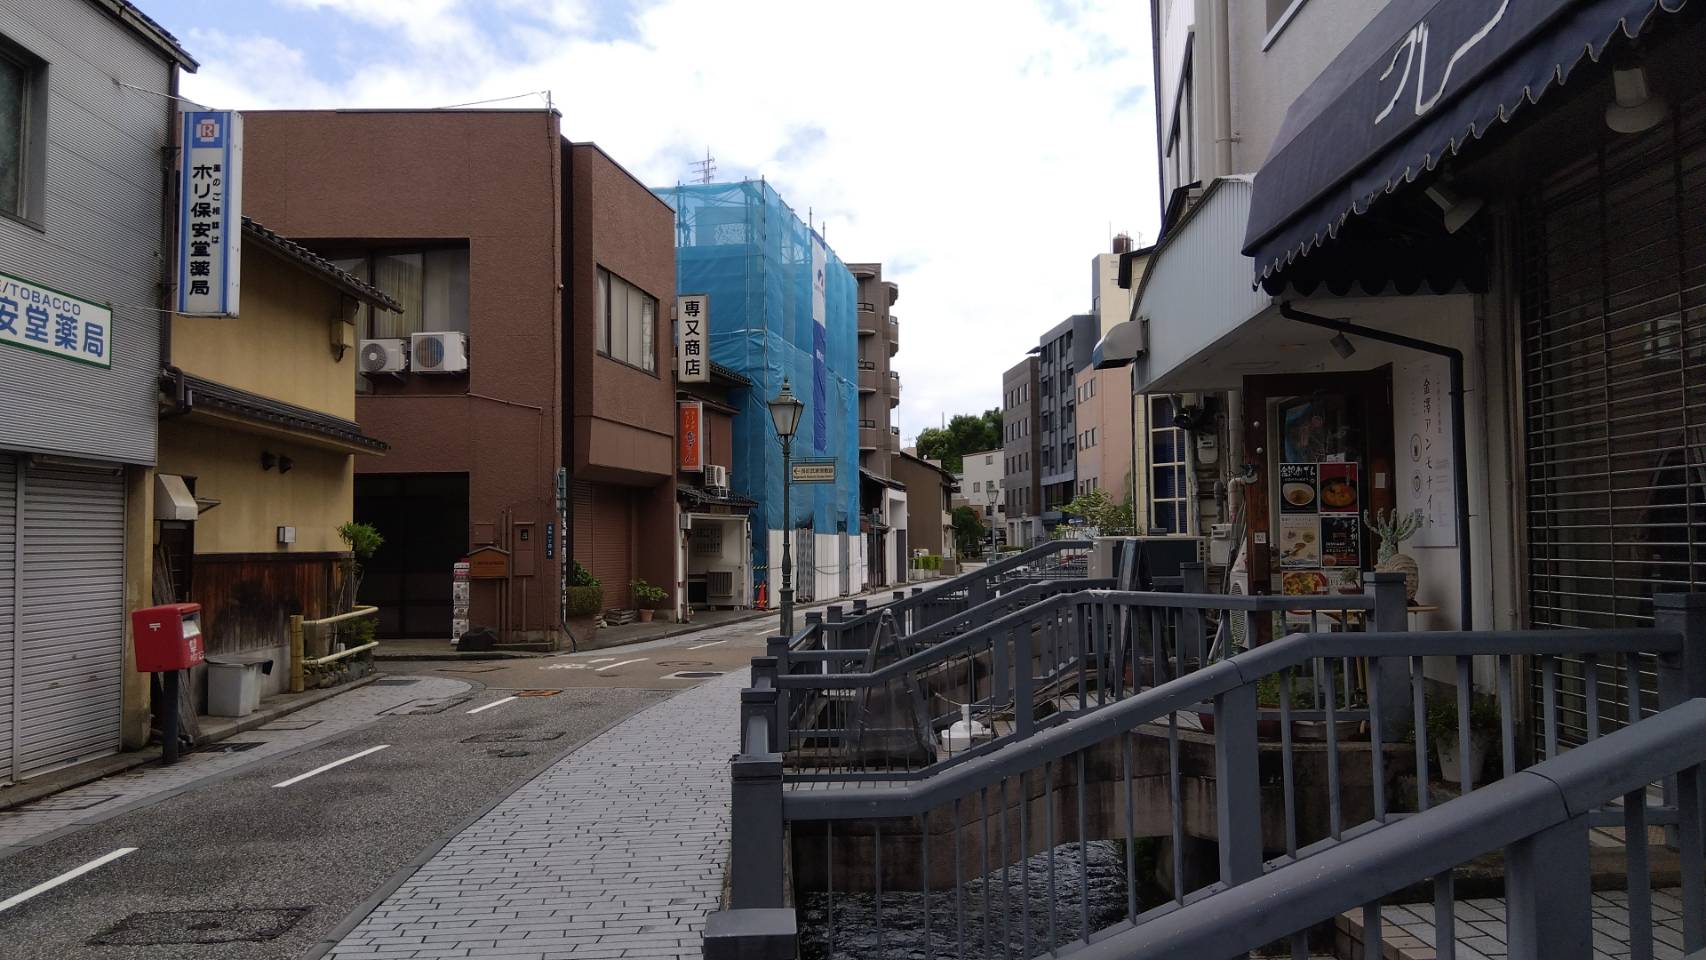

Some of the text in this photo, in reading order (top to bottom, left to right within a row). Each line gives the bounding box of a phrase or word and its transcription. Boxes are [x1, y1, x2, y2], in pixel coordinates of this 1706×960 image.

[189, 164, 212, 295] ホリ保安堂薬局
[0, 279, 81, 316] /TOBACCO
[684, 300, 700, 376] 専又商店
